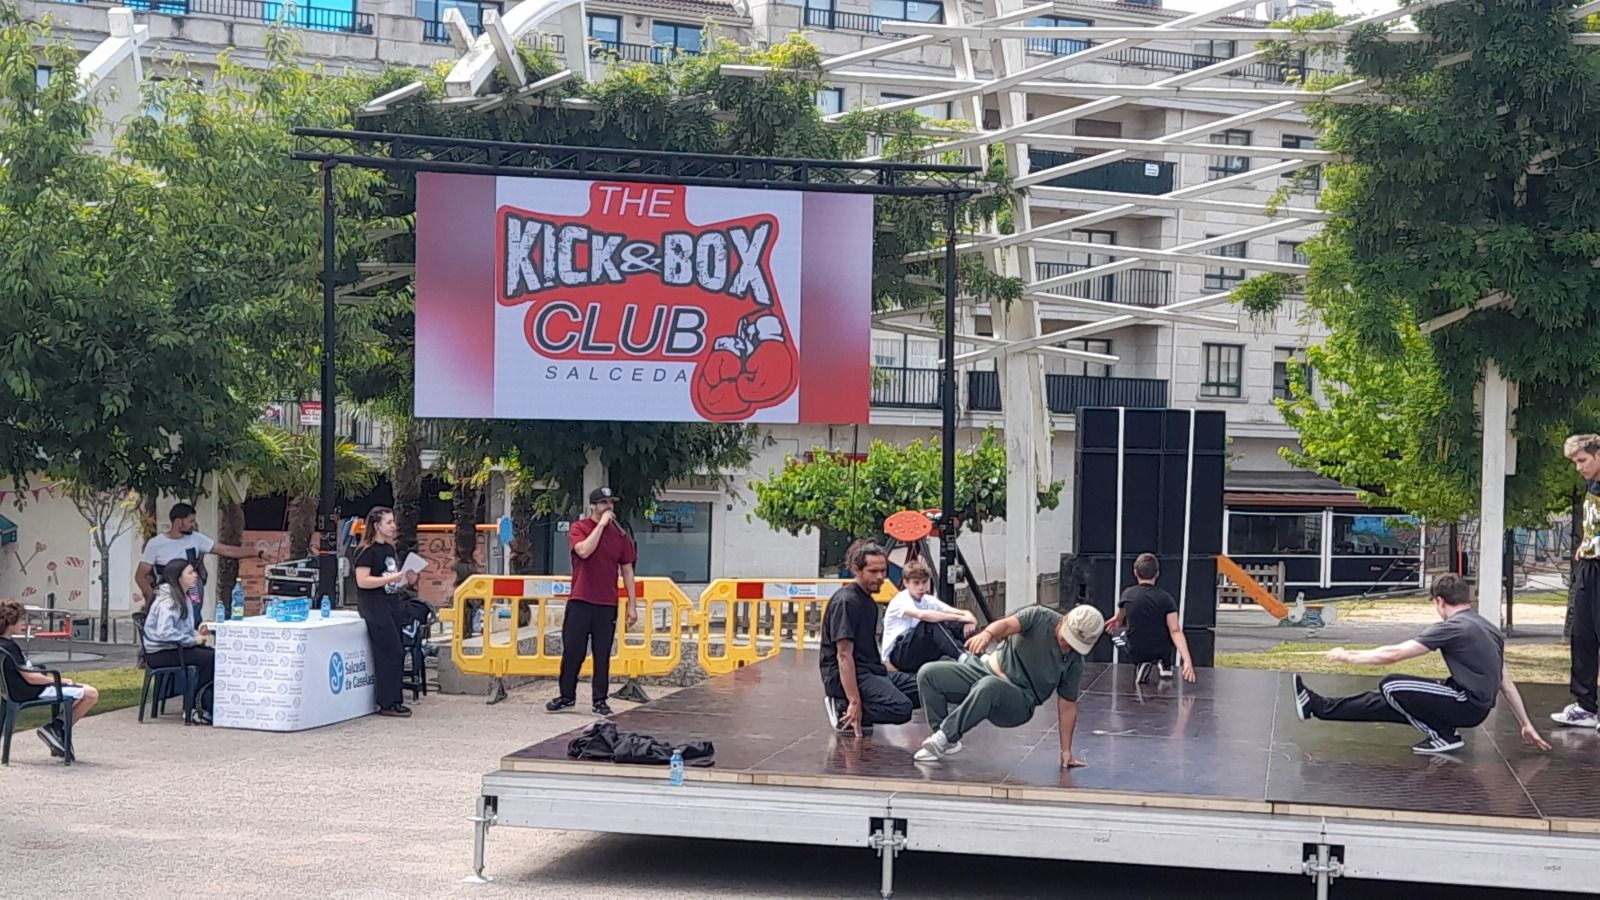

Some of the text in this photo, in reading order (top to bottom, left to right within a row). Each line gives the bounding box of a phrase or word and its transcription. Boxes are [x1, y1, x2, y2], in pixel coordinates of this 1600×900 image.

[598, 185, 675, 218] THE
[533, 301, 708, 357] CLUB
[545, 365, 688, 382] SALCEDA
